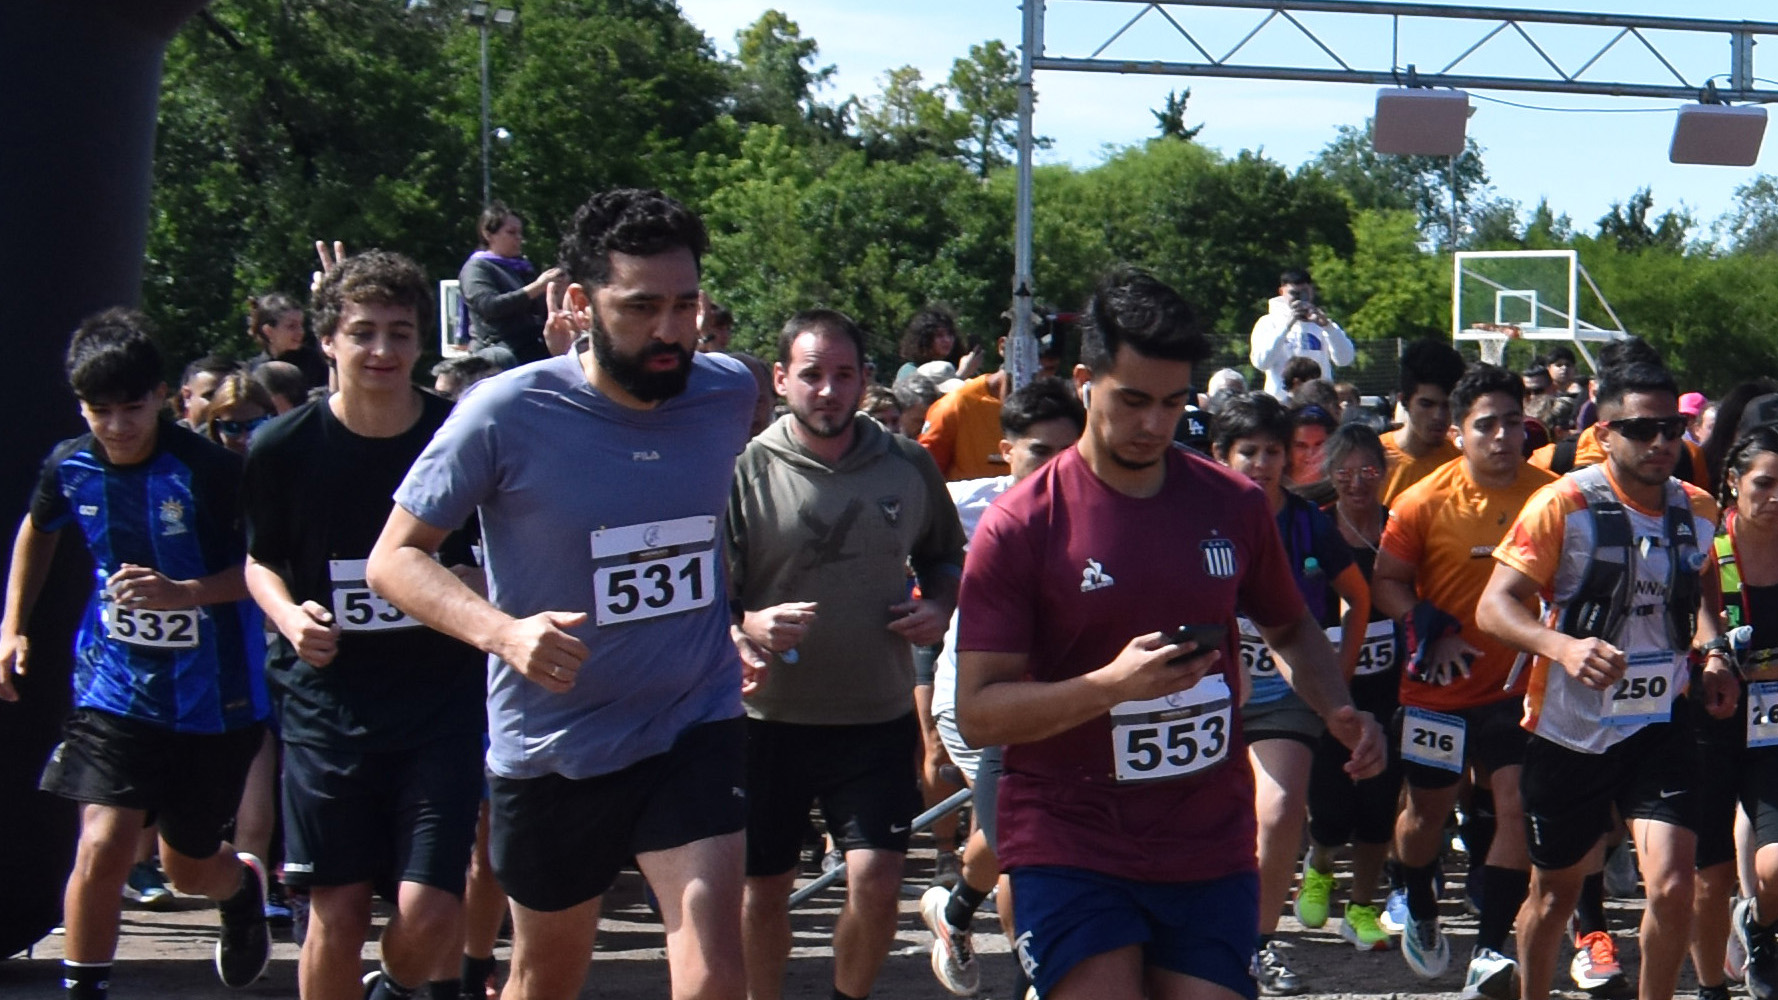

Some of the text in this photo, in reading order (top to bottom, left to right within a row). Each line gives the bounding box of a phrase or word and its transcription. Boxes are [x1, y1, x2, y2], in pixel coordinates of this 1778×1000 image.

[632, 451, 661, 462] FILA
[607, 556, 703, 615] 531
[116, 607, 194, 642] 532
[1613, 675, 1667, 701] 250
[1126, 715, 1226, 772] 553
[1412, 727, 1454, 752] 216
